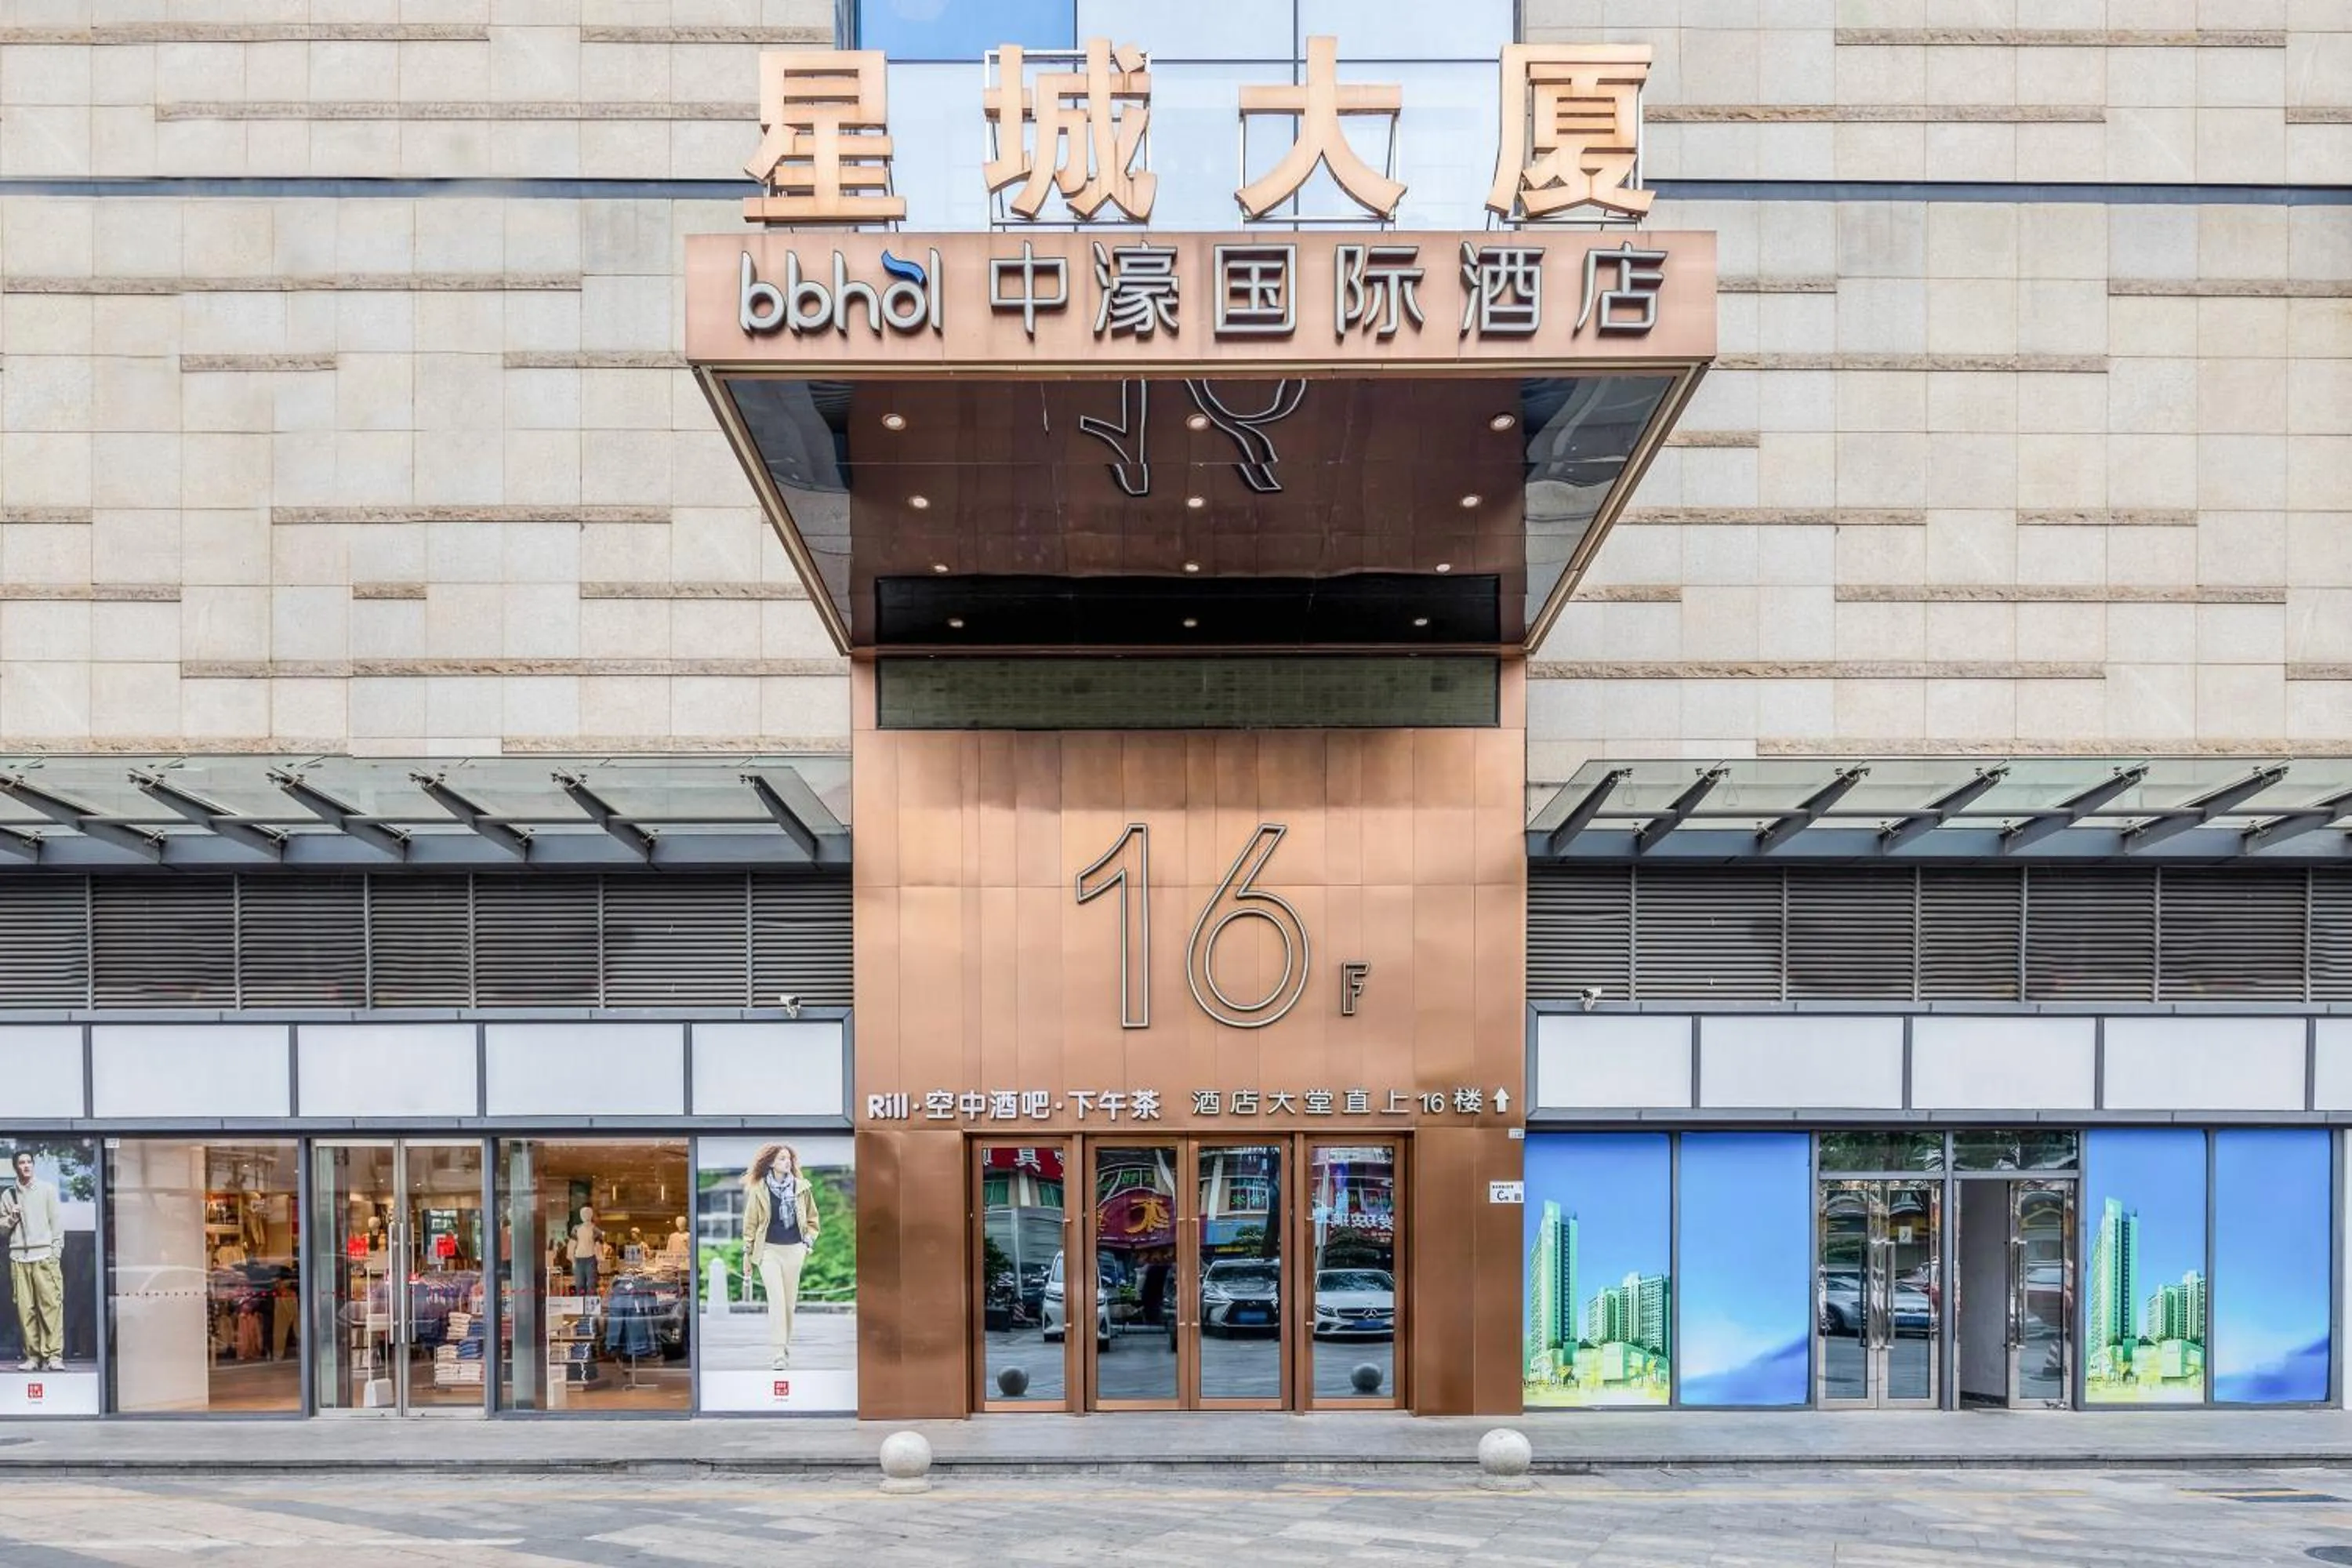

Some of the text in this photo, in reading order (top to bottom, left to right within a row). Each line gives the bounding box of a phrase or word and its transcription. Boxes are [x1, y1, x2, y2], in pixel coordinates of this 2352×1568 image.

[743, 35, 1657, 223] 星城大厦
[989, 240, 1667, 337] 中濠国际酒店
